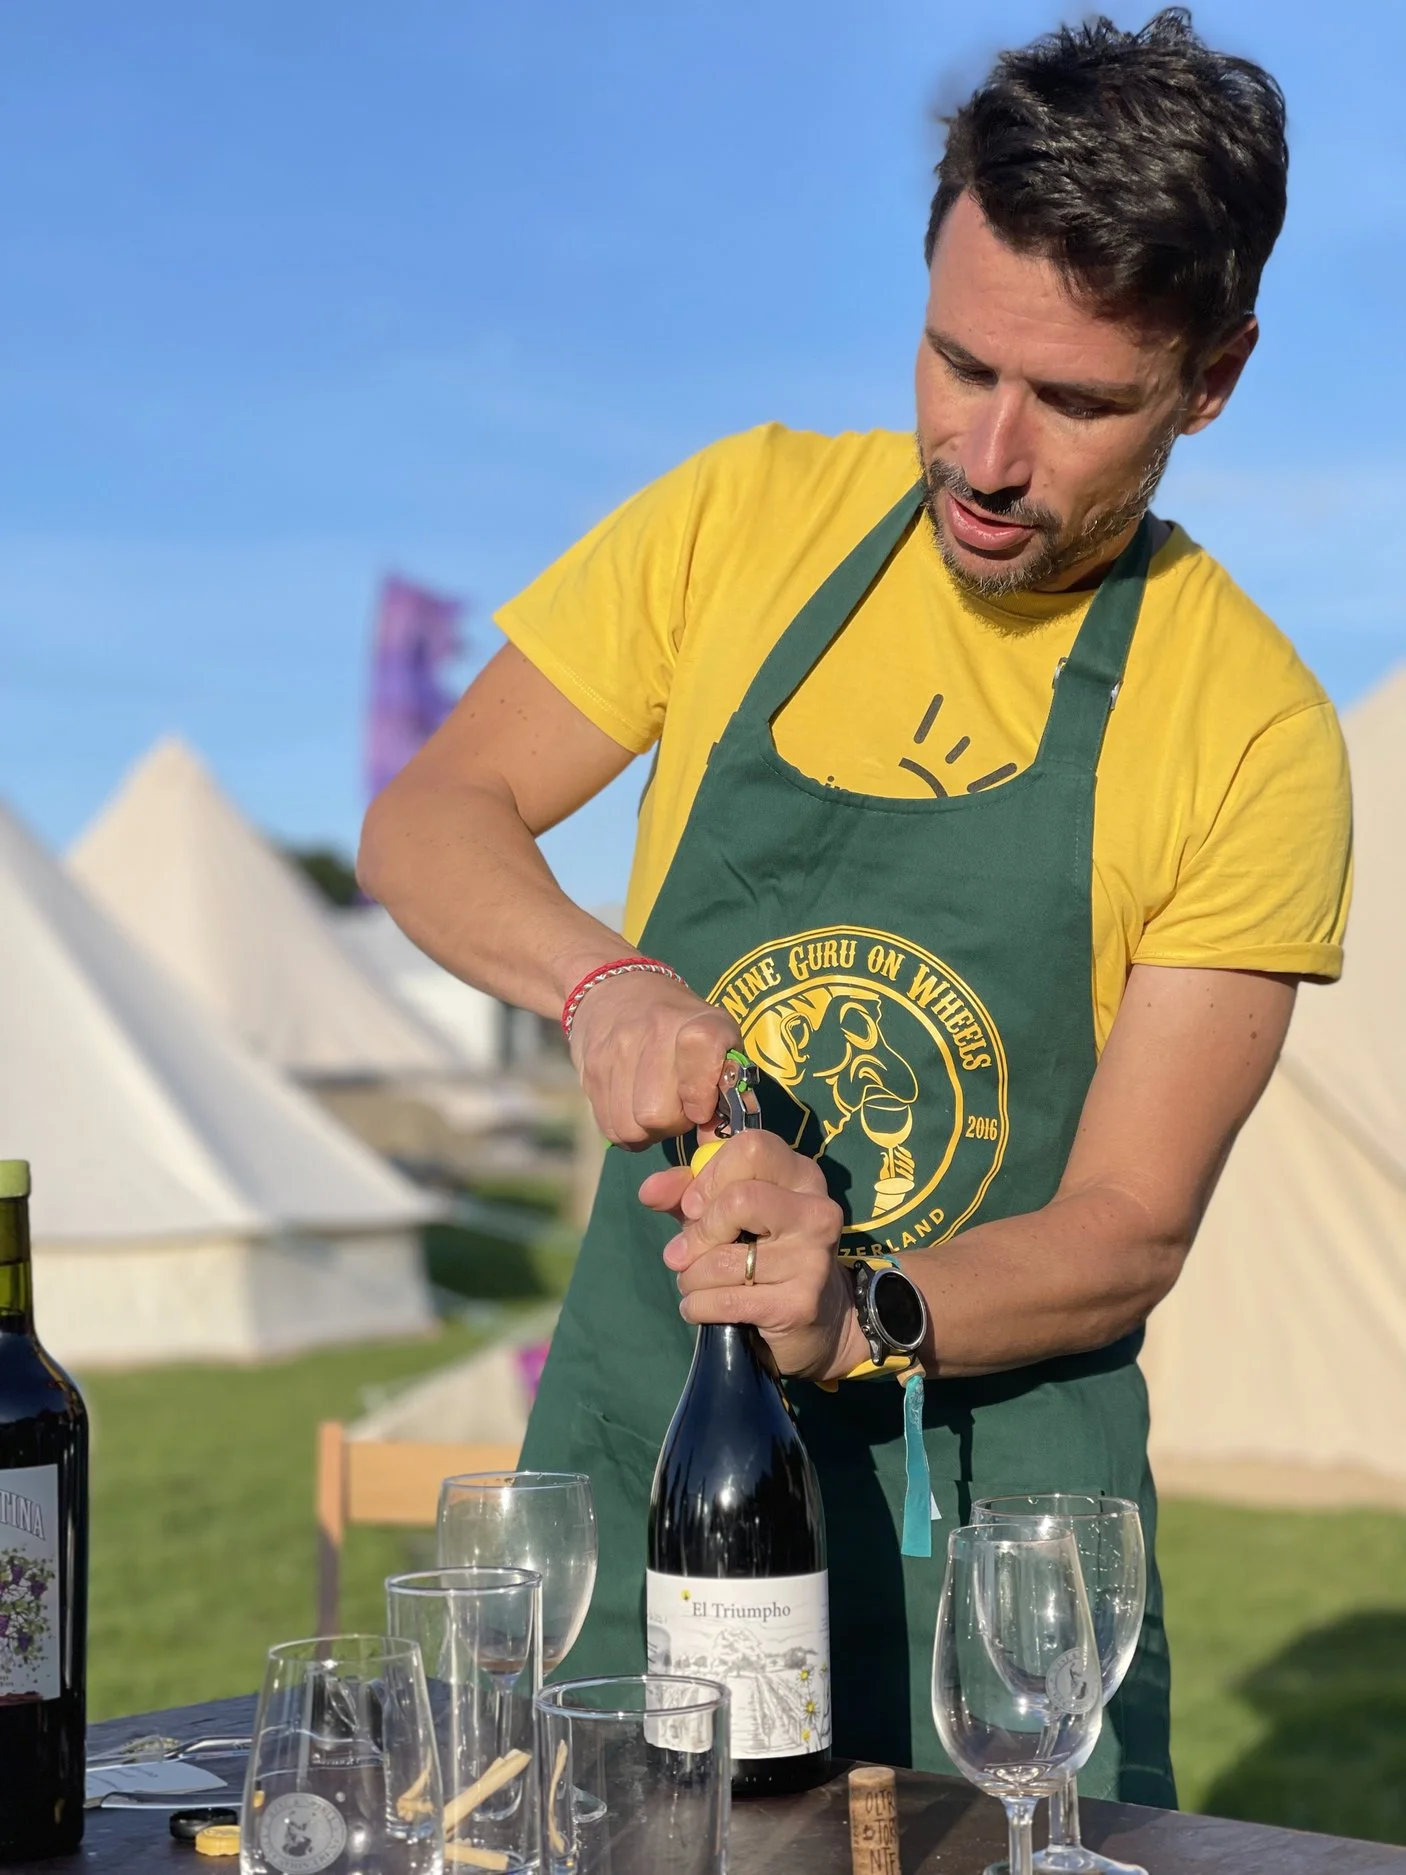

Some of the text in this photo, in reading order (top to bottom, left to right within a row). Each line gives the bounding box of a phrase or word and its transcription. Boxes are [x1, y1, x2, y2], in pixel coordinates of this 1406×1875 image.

[715, 939, 992, 1071] WINE GURU ON WHEELS
[965, 1115, 998, 1141] 2016
[840, 1208, 945, 1257] ZERLAND
[692, 1601, 792, 1623] El Triumpho
